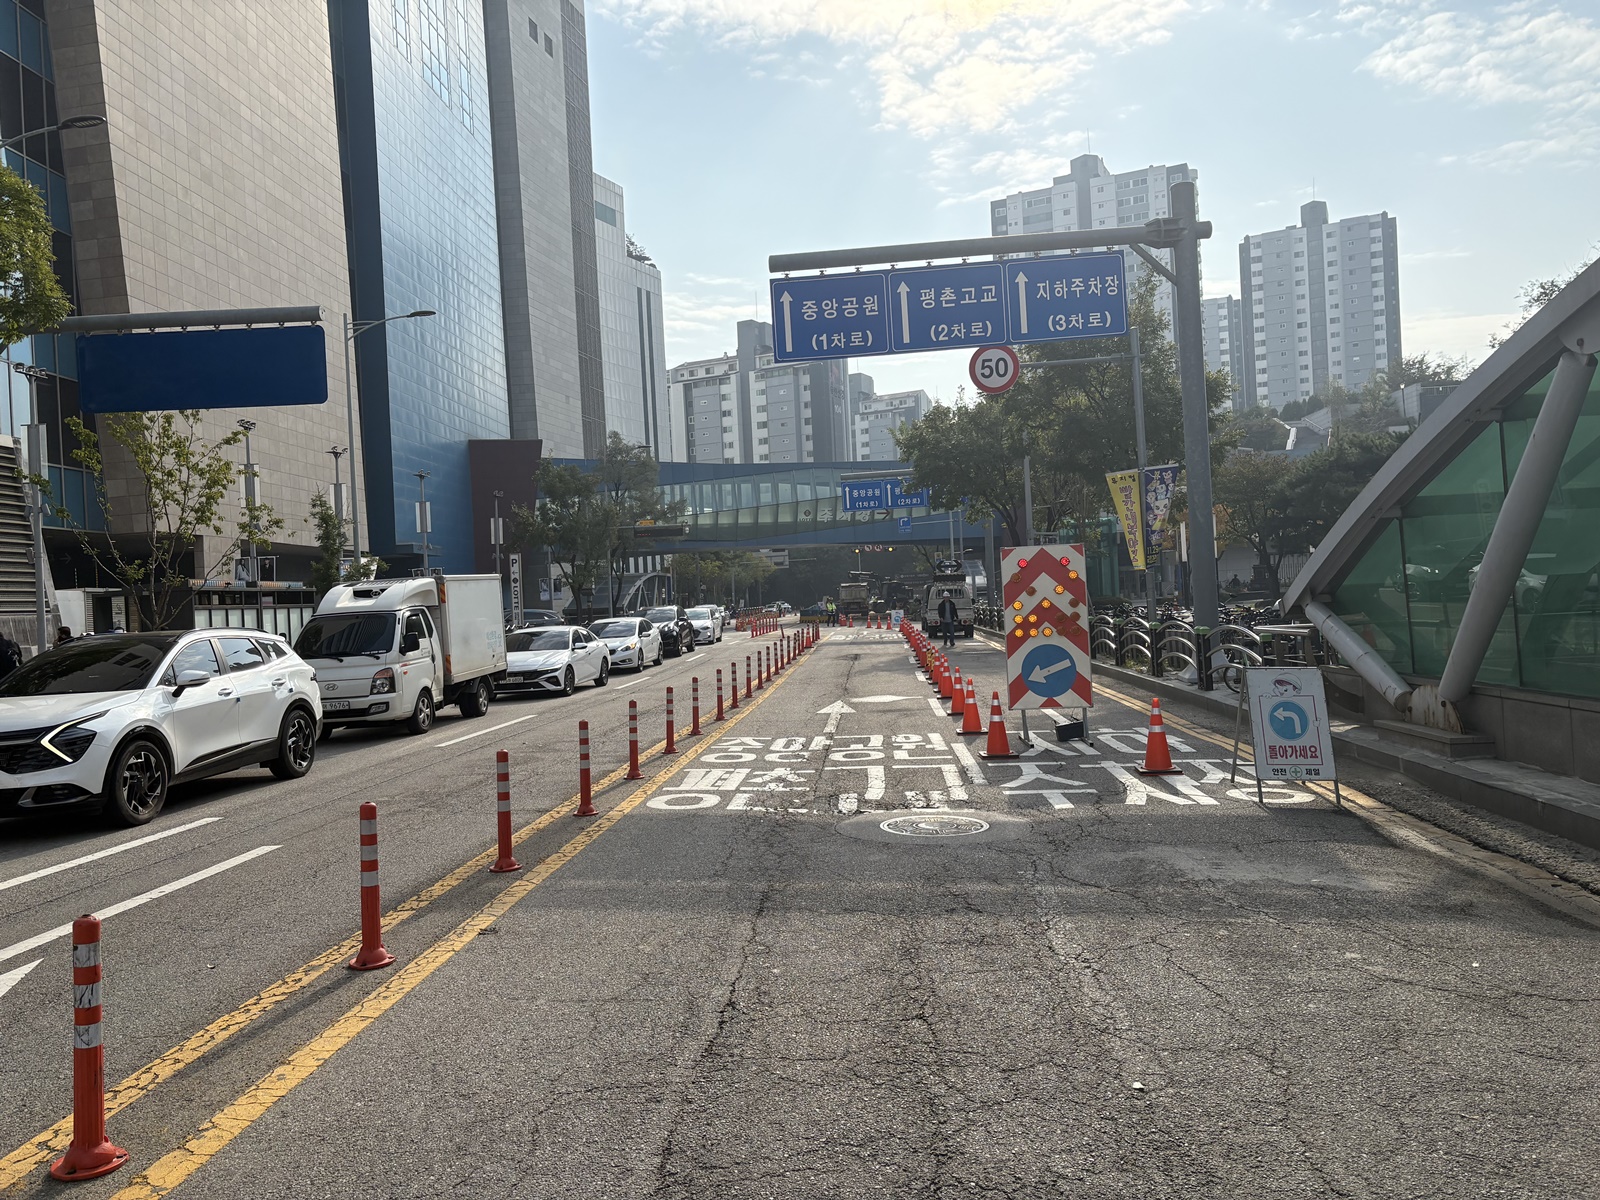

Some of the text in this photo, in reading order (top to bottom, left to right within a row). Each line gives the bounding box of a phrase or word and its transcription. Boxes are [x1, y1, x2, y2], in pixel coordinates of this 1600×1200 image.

[919, 285, 998, 309] 평촌고교
[1036, 274, 1120, 301] 지하주차장
[801, 294, 879, 321] 중앙공원
[929, 320, 993, 342] (2차로)
[1047, 310, 1113, 332] (3차로)
[811, 329, 873, 351] (1차로)
[980, 357, 1009, 379] 50
[1111, 475, 1136, 485] 뮤지컬
[852, 488, 880, 498] 중앙공원
[511, 558, 518, 568] P
[329, 702, 346, 711] 9676
[700, 732, 953, 763] 중앙공원
[1268, 744, 1319, 760] 돌아가세요
[1271, 768, 1321, 776] 안전 제일
